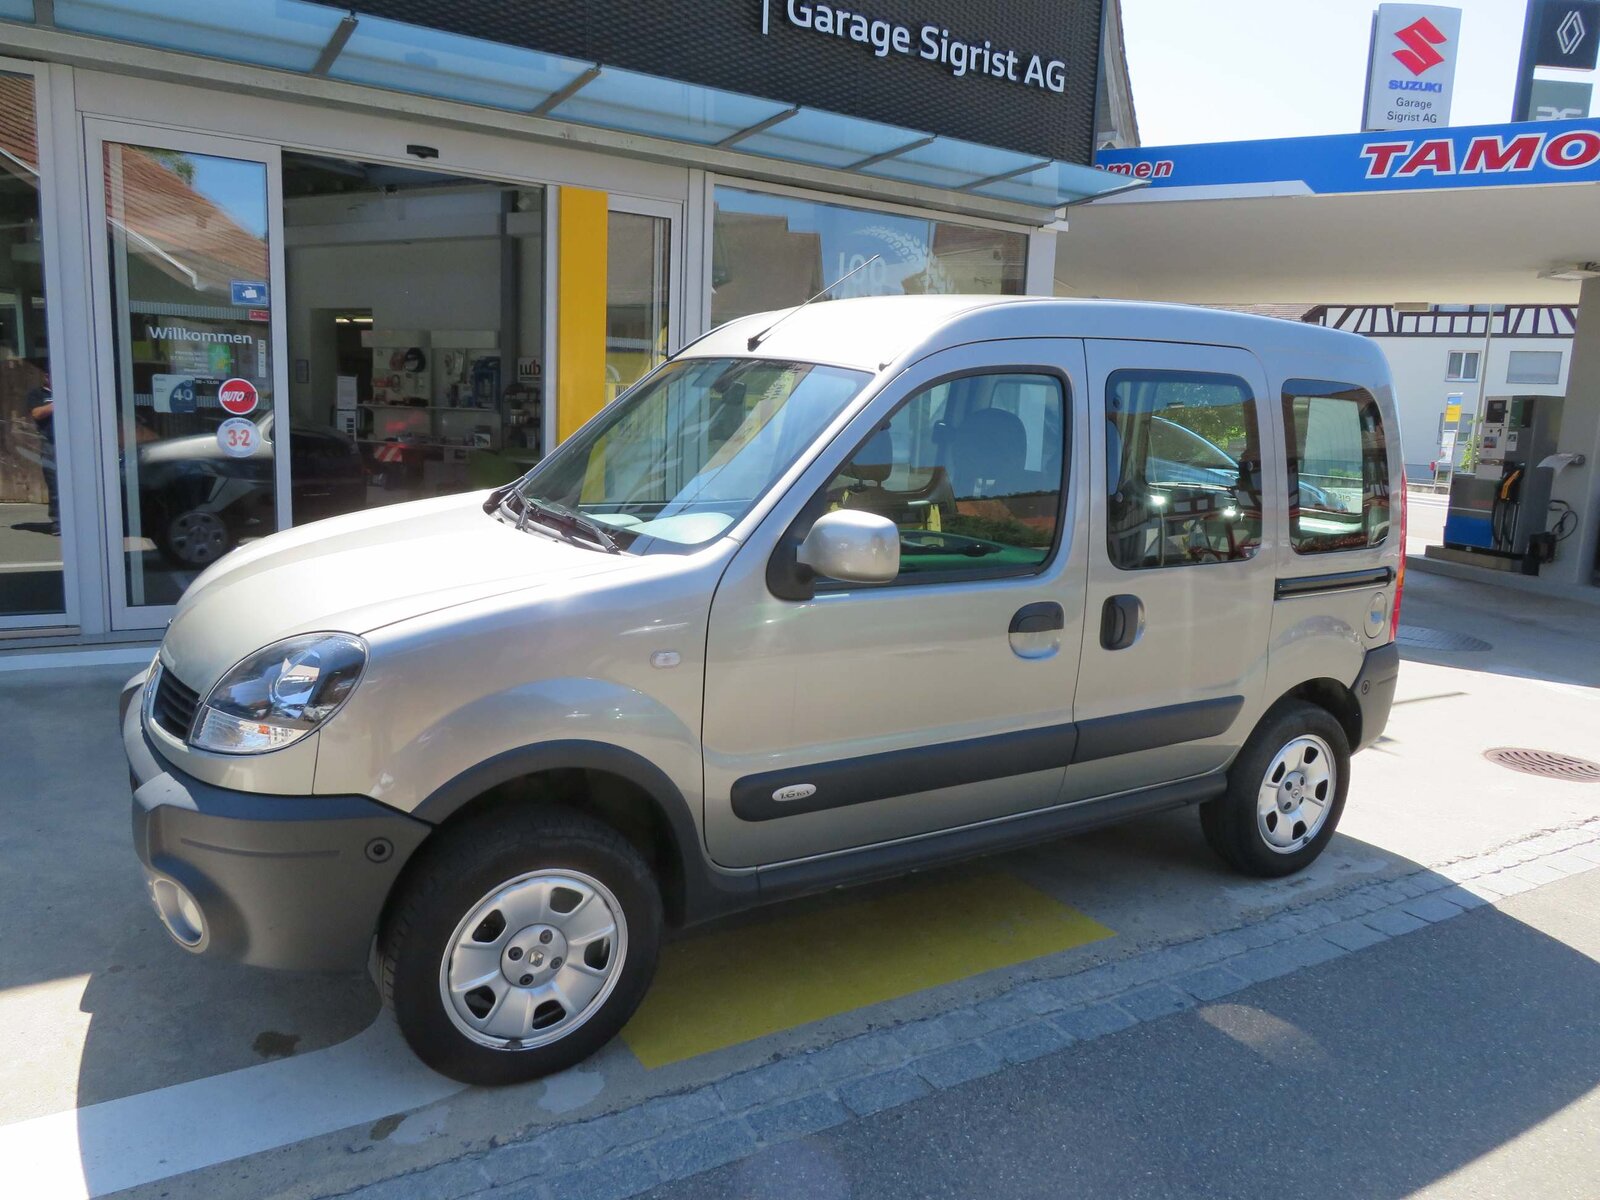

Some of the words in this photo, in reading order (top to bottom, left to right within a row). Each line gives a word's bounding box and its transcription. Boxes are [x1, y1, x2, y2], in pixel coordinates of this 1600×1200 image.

[787, 0, 910, 57] Garage
[920, 25, 1017, 81] Sigrist
[1024, 55, 1066, 92] AG
[1388, 79, 1442, 93] SUZUKI
[1396, 97, 1432, 110] Garage
[1387, 110, 1420, 122] Sigrist
[1422, 113, 1437, 123] AG
[149, 326, 253, 345] Willkommen
